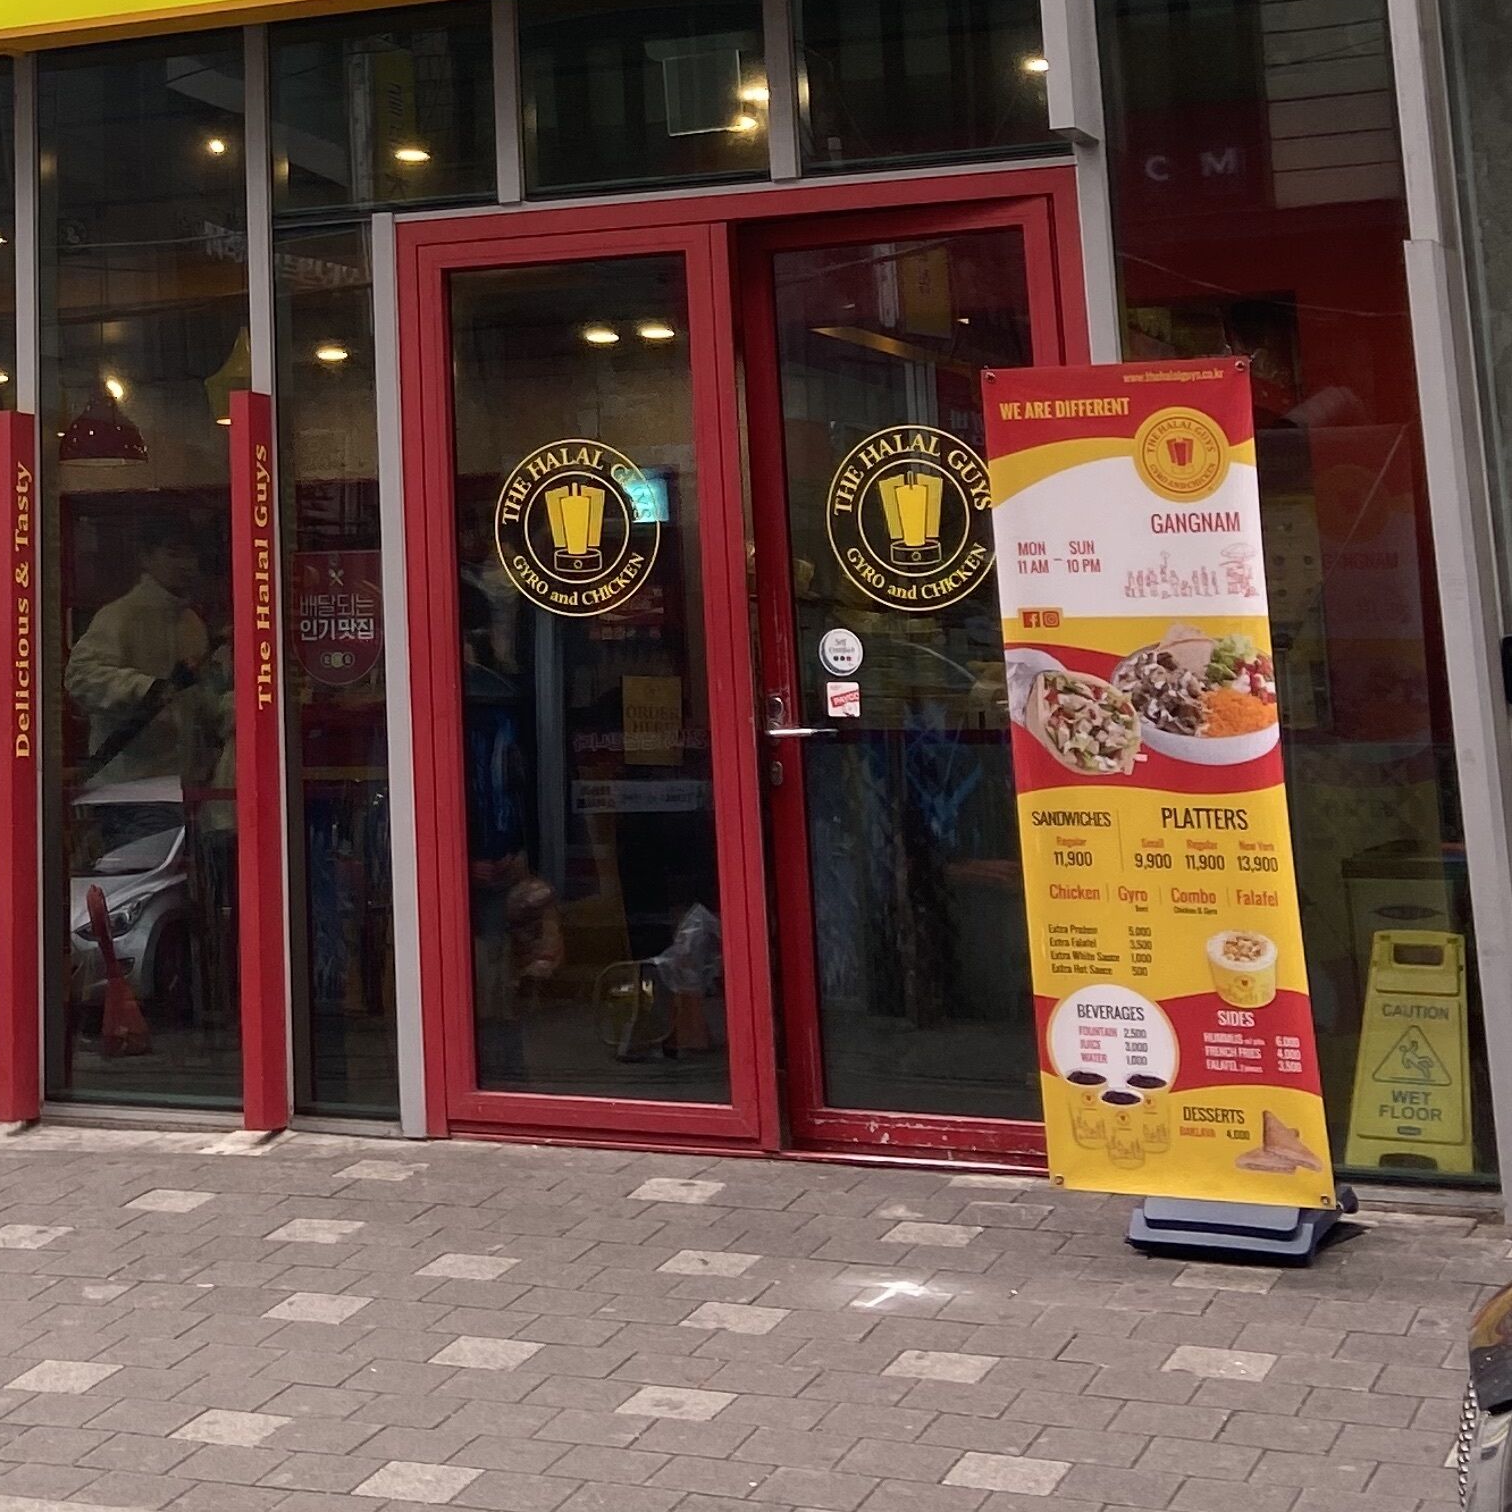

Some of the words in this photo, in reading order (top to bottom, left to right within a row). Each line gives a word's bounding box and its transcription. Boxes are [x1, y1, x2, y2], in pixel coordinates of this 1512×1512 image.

[1000, 402, 1022, 420] WE
[1025, 400, 1052, 419] ARE
[1055, 397, 1130, 419] DIFFERENT
[834, 465, 865, 516] THE
[857, 433, 941, 470] HALAL
[947, 449, 993, 512] GUYS
[254, 445, 270, 528] Guys
[502, 476, 532, 525] THE
[526, 447, 604, 482] HALAL
[15, 462, 34, 552] Tasty
[1150, 512, 1241, 534] GANGNAM
[1018, 542, 1046, 556] MON
[1068, 540, 1095, 555] SUN
[15, 562, 30, 588] &
[847, 547, 885, 589] GYRO
[888, 584, 918, 600] and
[921, 542, 988, 600] CHICKEN
[1018, 561, 1030, 574] 11
[1032, 559, 1049, 574] AM
[1067, 559, 1079, 573] 10
[1082, 559, 1101, 573] PM
[256, 538, 270, 629] Halal
[513, 555, 549, 595] GYRO
[550, 591, 578, 606] and
[582, 552, 645, 606] CHICKEN
[300, 594, 374, 617] 배달되는
[300, 618, 374, 641] 인기맛집
[16, 598, 31, 758] Delicious
[257, 641, 272, 710] The
[1032, 811, 1111, 828] SANDWICHES
[1161, 807, 1249, 831] PLATTERS
[1054, 851, 1093, 868] 11,900
[1135, 853, 1172, 870] 9,900
[1185, 854, 1226, 871] 11,900
[1237, 855, 1279, 873] 13,900
[1049, 884, 1100, 900] Chicken
[1118, 886, 1148, 903] Gyro
[1171, 888, 1217, 904] Combo
[1236, 889, 1279, 907] Falafel
[1048, 924, 1068, 933] Extra
[1049, 937, 1070, 947] Extra
[1050, 951, 1071, 960] Extra
[1072, 951, 1095, 960] White
[1051, 963, 1072, 973] Extra
[1074, 964, 1088, 974] Hot
[1077, 1004, 1145, 1021] BEVERAGES
[1217, 1010, 1255, 1027] SIDES
[1381, 1003, 1449, 1021] CAUTION
[1080, 1053, 1108, 1064] WATER
[1391, 1089, 1432, 1106] WET
[1183, 1106, 1245, 1124] DESSERTS
[1378, 1104, 1442, 1122] FLOOR
